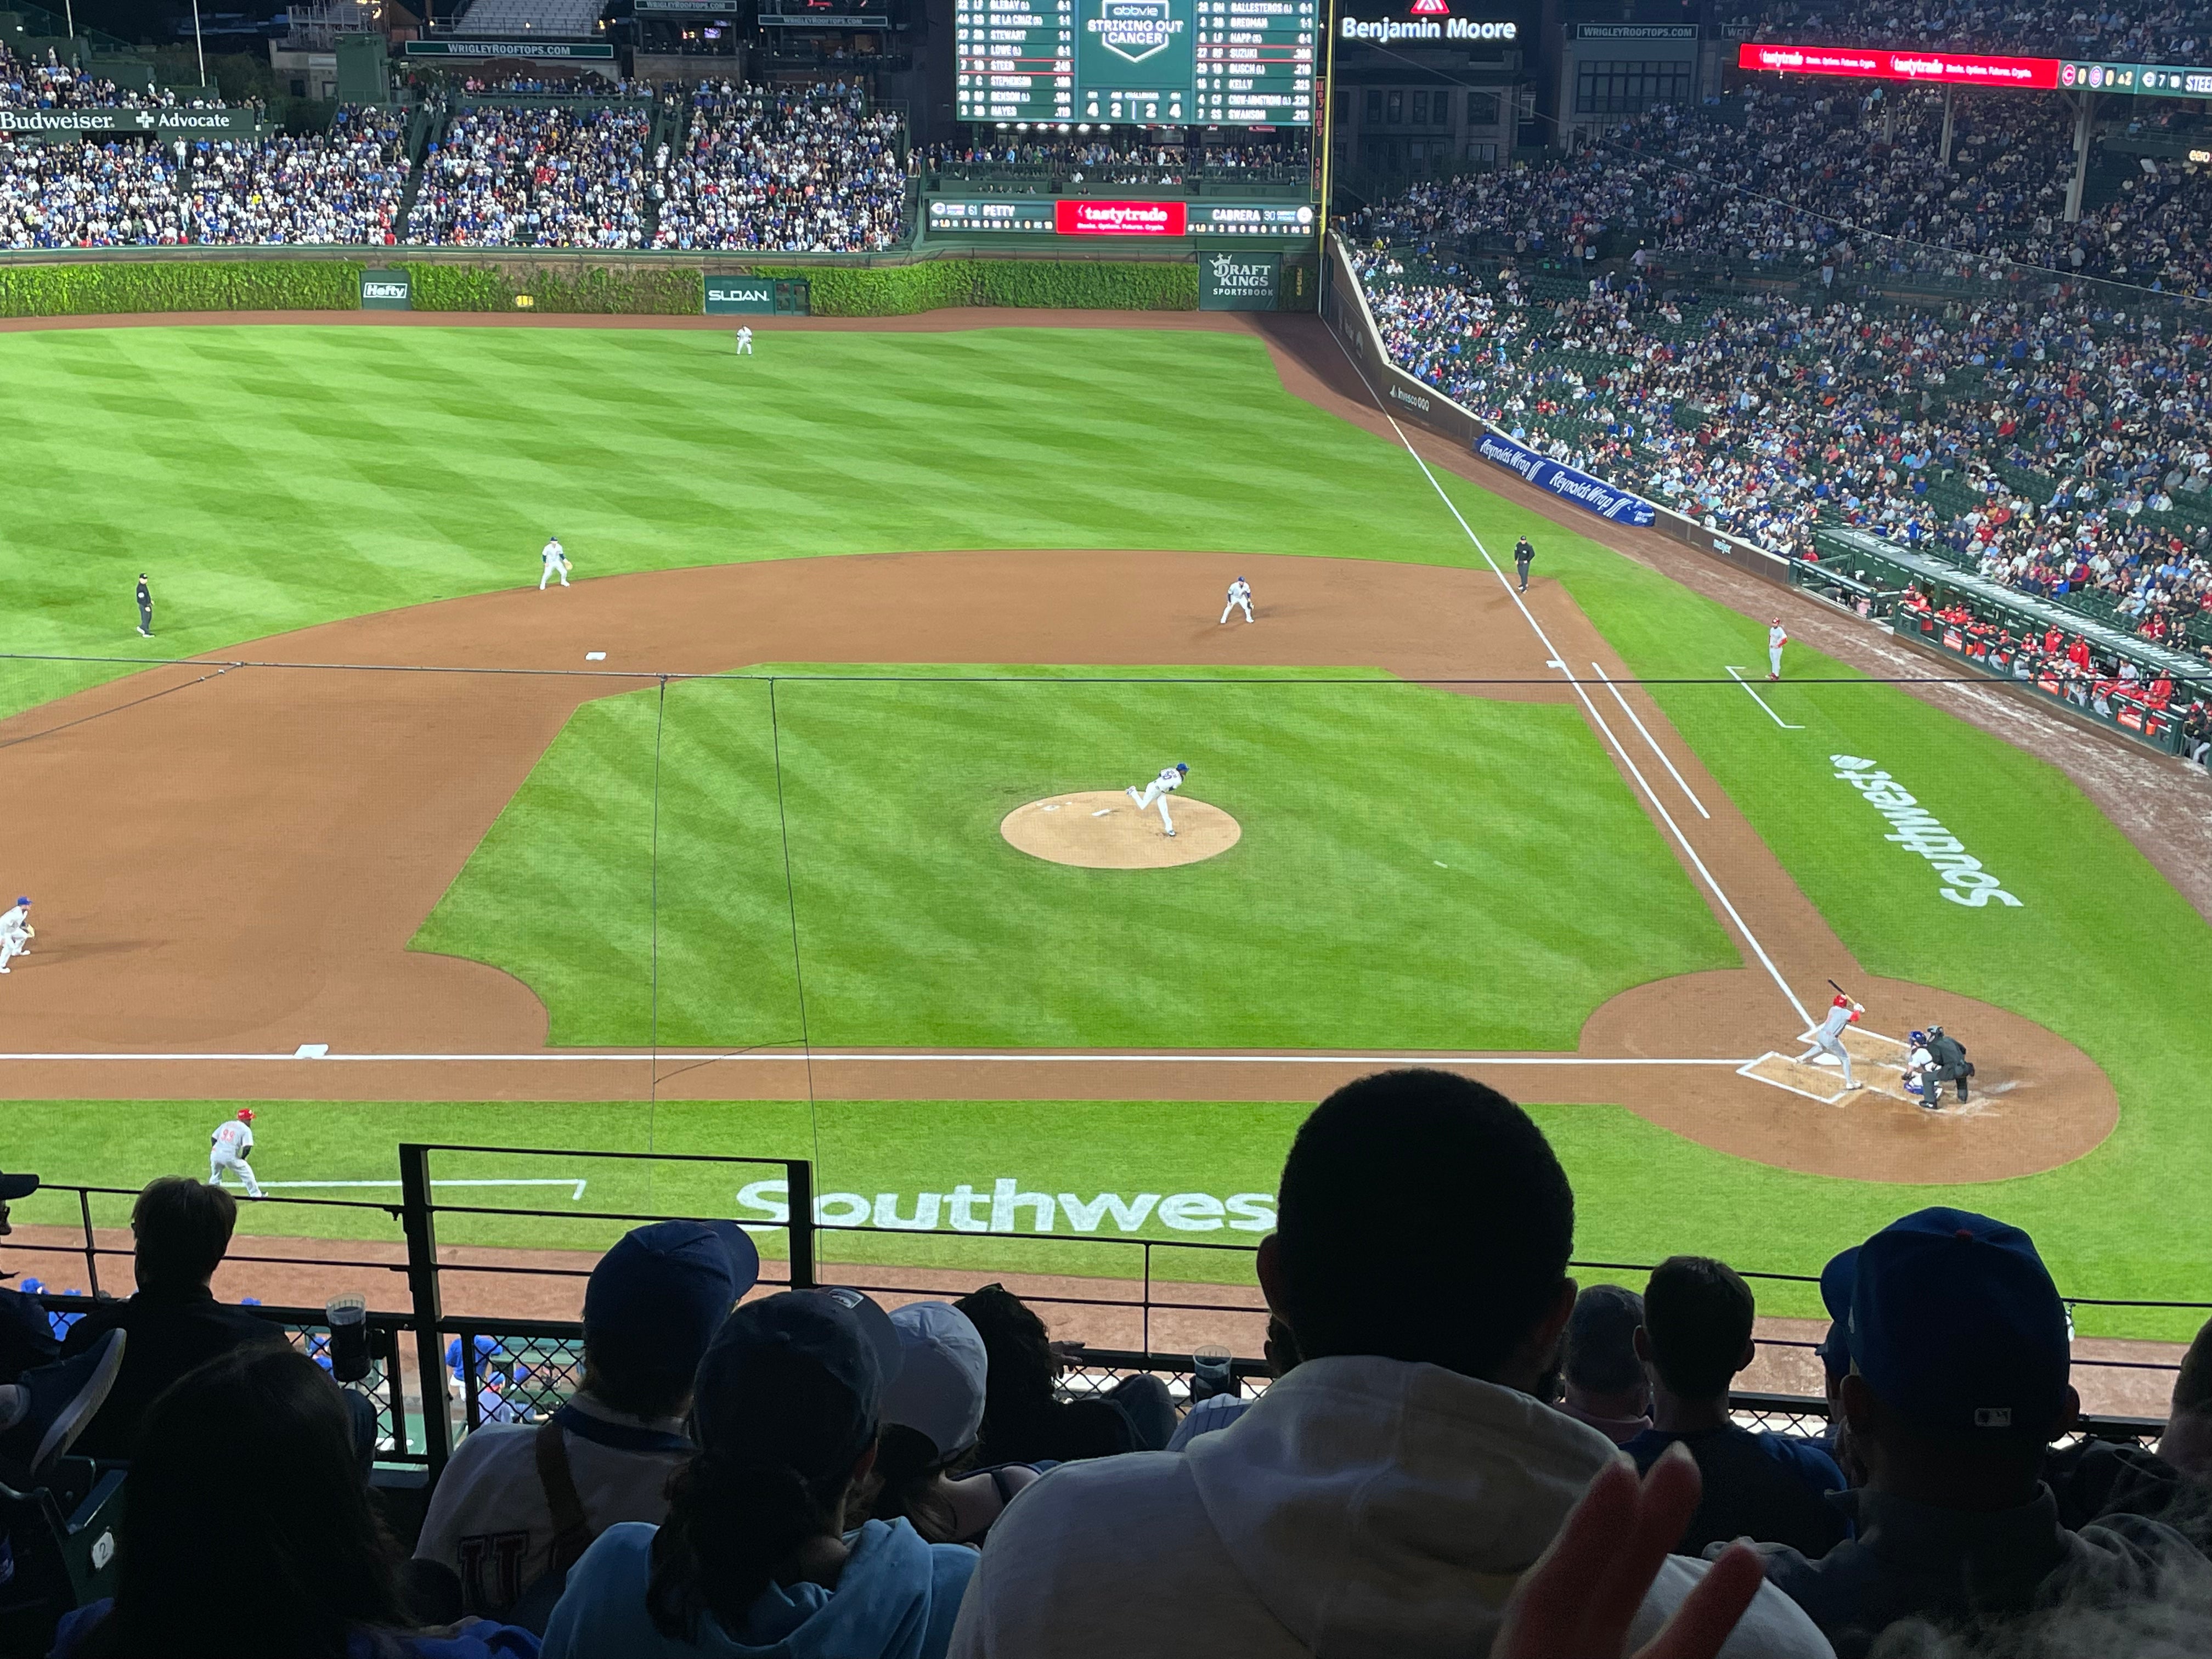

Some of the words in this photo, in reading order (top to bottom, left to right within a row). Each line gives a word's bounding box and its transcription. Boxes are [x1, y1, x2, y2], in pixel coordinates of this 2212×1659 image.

[1113, 5, 1159, 16] abbvie
[1231, 2, 1283, 13] BALLESTEROS
[1087, 19, 1153, 32] STRIKING
[1155, 20, 1184, 33] OUT
[1231, 18, 1268, 28] BREGMAN
[990, 30, 1026, 41] STEWART
[1342, 16, 1441, 43] Benjamin
[1446, 18, 1517, 39] Moore
[1583, 26, 1692, 37] WRIGLEYROOFTOPS.COM
[1108, 32, 1163, 44] CANCER
[447, 44, 571, 55] WRIGLEYROOFTOPS.COM
[991, 44, 1012, 55] LOWE
[1229, 48, 1258, 59] SUZUKI
[1763, 50, 1803, 67] tastytrade
[990, 60, 1015, 71] STEER
[1229, 64, 1255, 75] BUSCH
[1894, 58, 1944, 76] tastytrade
[1229, 79, 1253, 90] KELLY
[2125, 71, 2133, 86] 2
[2159, 74, 2166, 87] 7
[2185, 75, 2212, 93] STEE
[991, 105, 1017, 116] HAYES
[1087, 102, 1099, 117] 4
[1110, 103, 1122, 117] 2
[1146, 103, 1156, 118] 2
[1169, 103, 1181, 118] 4
[1228, 109, 1266, 120] SWANSON
[0, 112, 112, 129] Budweiser
[159, 113, 230, 127] Advocate
[983, 205, 1015, 217] PETTY
[1085, 207, 1168, 224] tastytrade
[1212, 209, 1261, 221] CABRERA
[1213, 264, 1271, 277] DRAFT
[1220, 275, 1269, 286] KINGS
[366, 284, 405, 297] Hefty
[708, 290, 768, 301] SLOAN
[1398, 387, 1417, 407] Invesco
[1418, 397, 1429, 411] QQQ
[1480, 438, 1513, 464] Reynolds
[1509, 450, 1531, 477] Wrap
[1549, 471, 1590, 499] Reynolds
[1586, 486, 1614, 511] Wrap
[1833, 770, 2024, 907] Southwest
[736, 1178, 1279, 1232] Southwes
[99, 1542, 108, 1560] 2
